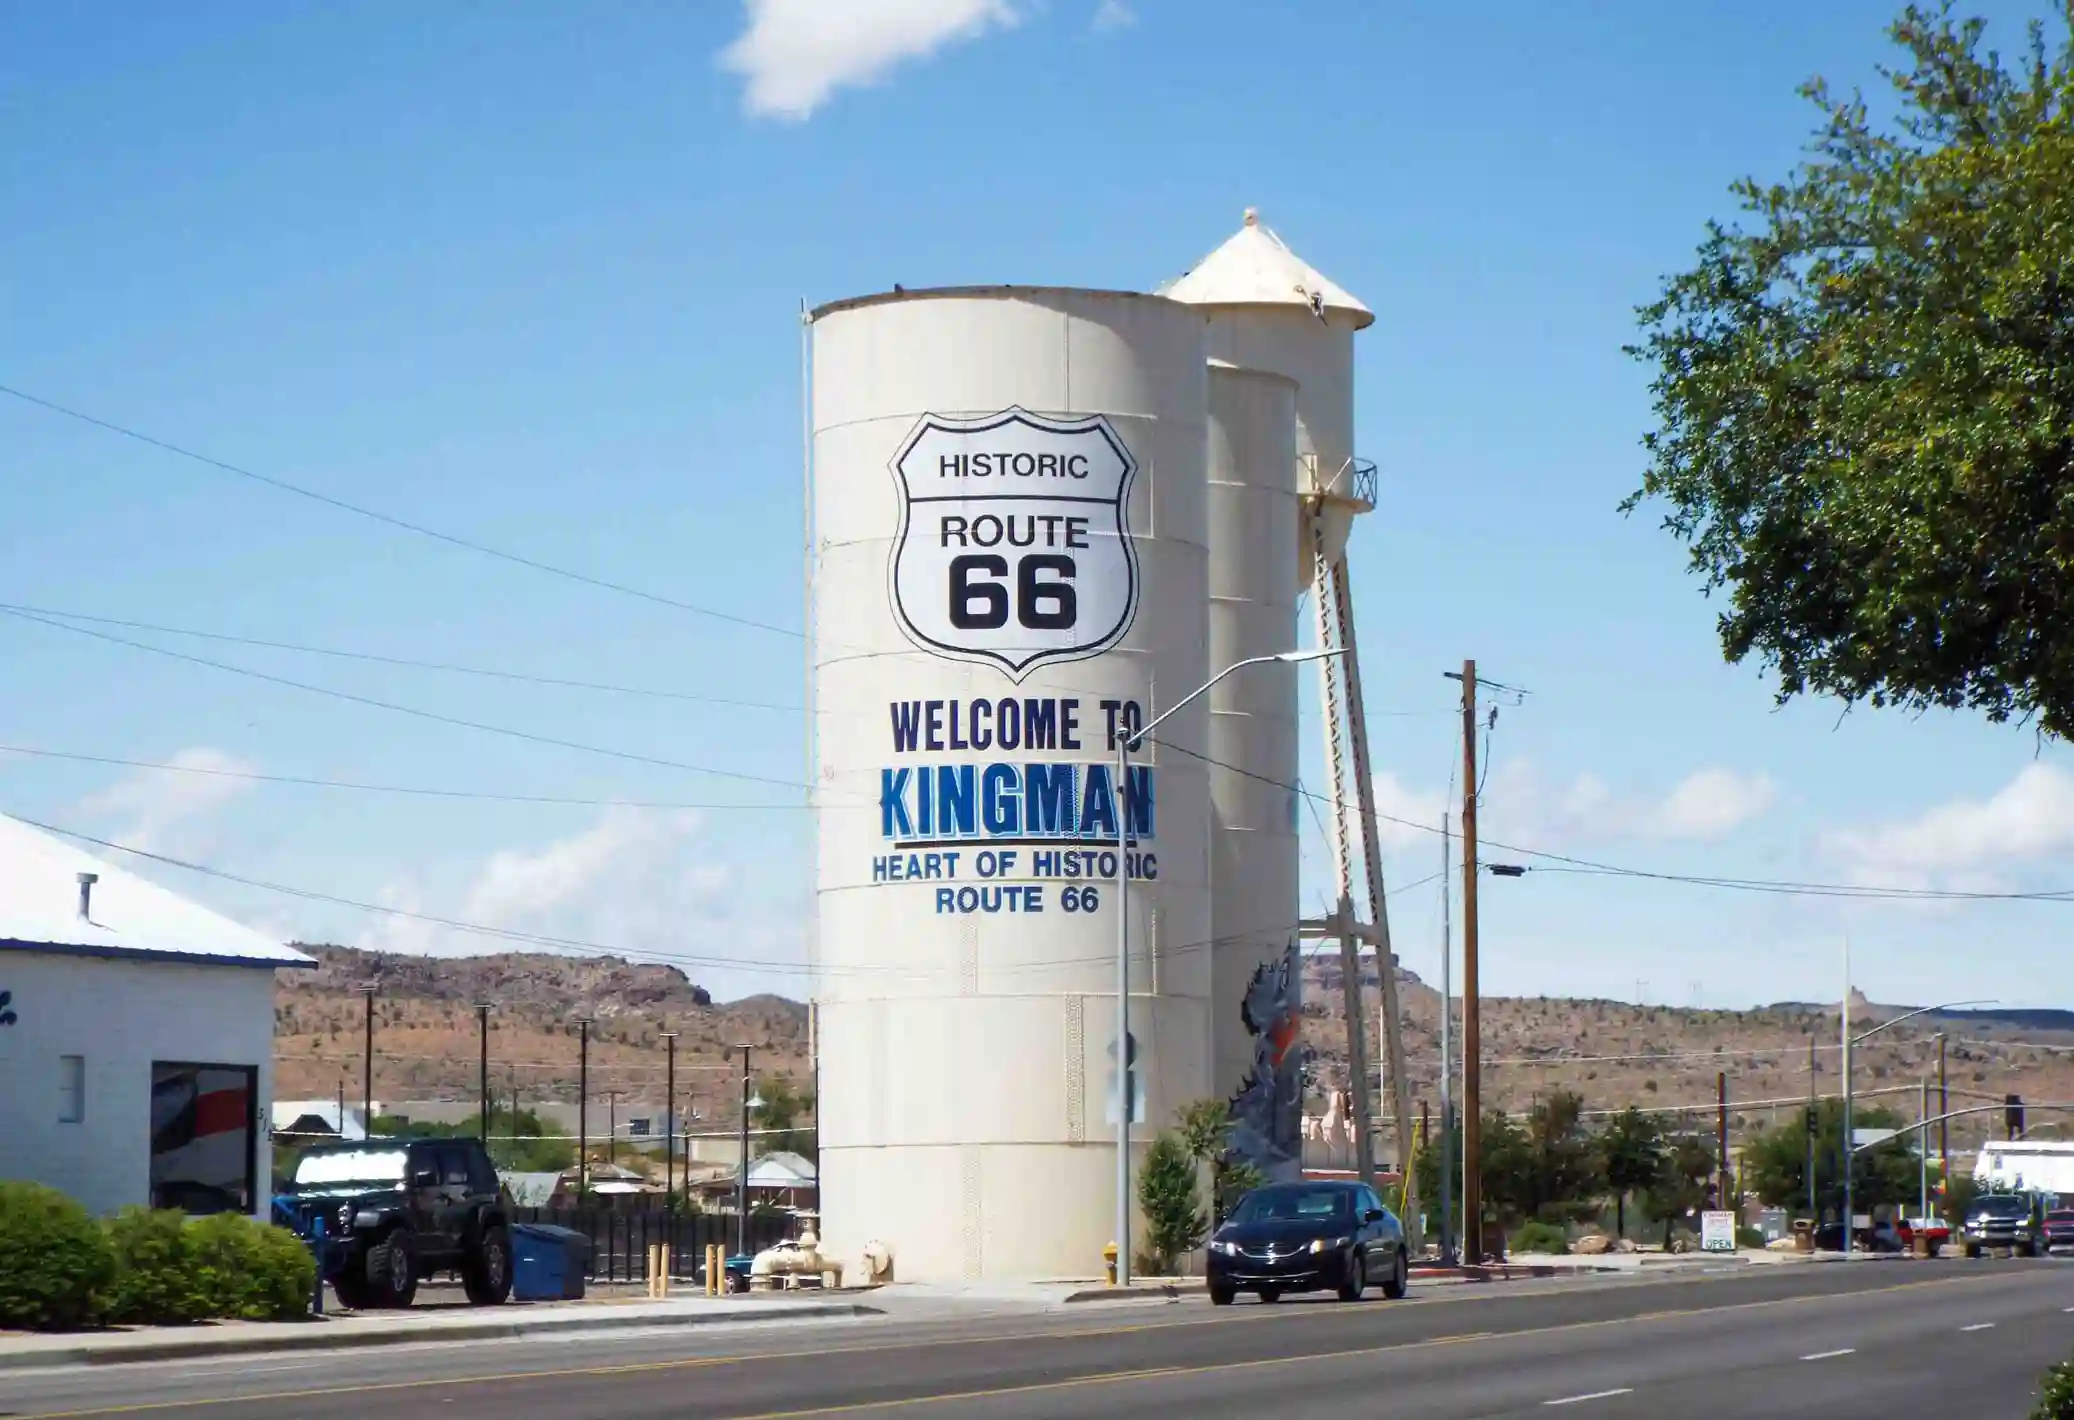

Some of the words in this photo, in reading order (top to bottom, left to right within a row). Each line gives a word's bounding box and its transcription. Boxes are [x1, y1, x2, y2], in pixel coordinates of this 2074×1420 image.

[940, 453, 1088, 479] HISTORIC
[941, 514, 1089, 548] ROUTE
[949, 554, 1076, 629] 66
[890, 697, 1081, 752] WELCOME
[1100, 700, 1142, 752] TO
[880, 763, 1155, 840] KINGMAN
[873, 853, 960, 881] HEART
[976, 851, 1017, 879] OF
[1033, 851, 1157, 880] HISTORIC
[936, 886, 1043, 913] ROUTE
[1060, 886, 1099, 913] 66
[1706, 1239, 1732, 1249] OPEN
